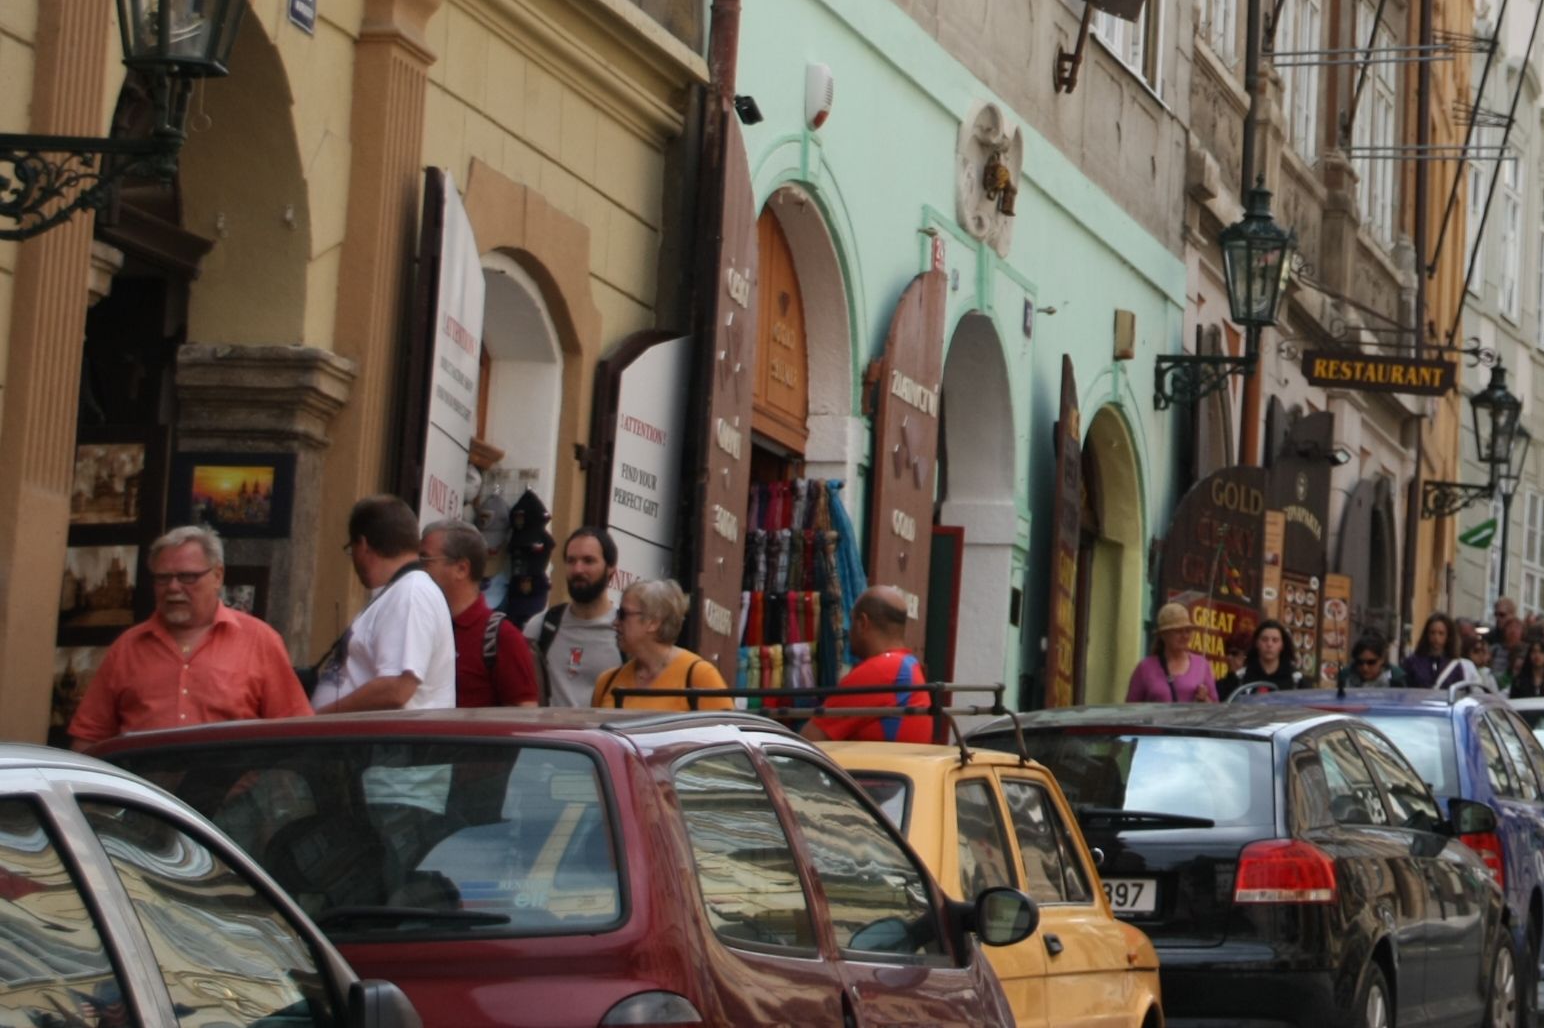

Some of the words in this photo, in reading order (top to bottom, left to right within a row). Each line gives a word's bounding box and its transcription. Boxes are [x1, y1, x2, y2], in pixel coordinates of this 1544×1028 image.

[1313, 358, 1445, 388] RESTAURANT
[621, 462, 638, 483] FIND
[639, 469, 658, 491] YOUR
[613, 487, 643, 512] PERFECT
[643, 498, 660, 519] GIFT
[1210, 477, 1264, 515] GOLD
[1192, 605, 1237, 634] GREAT
